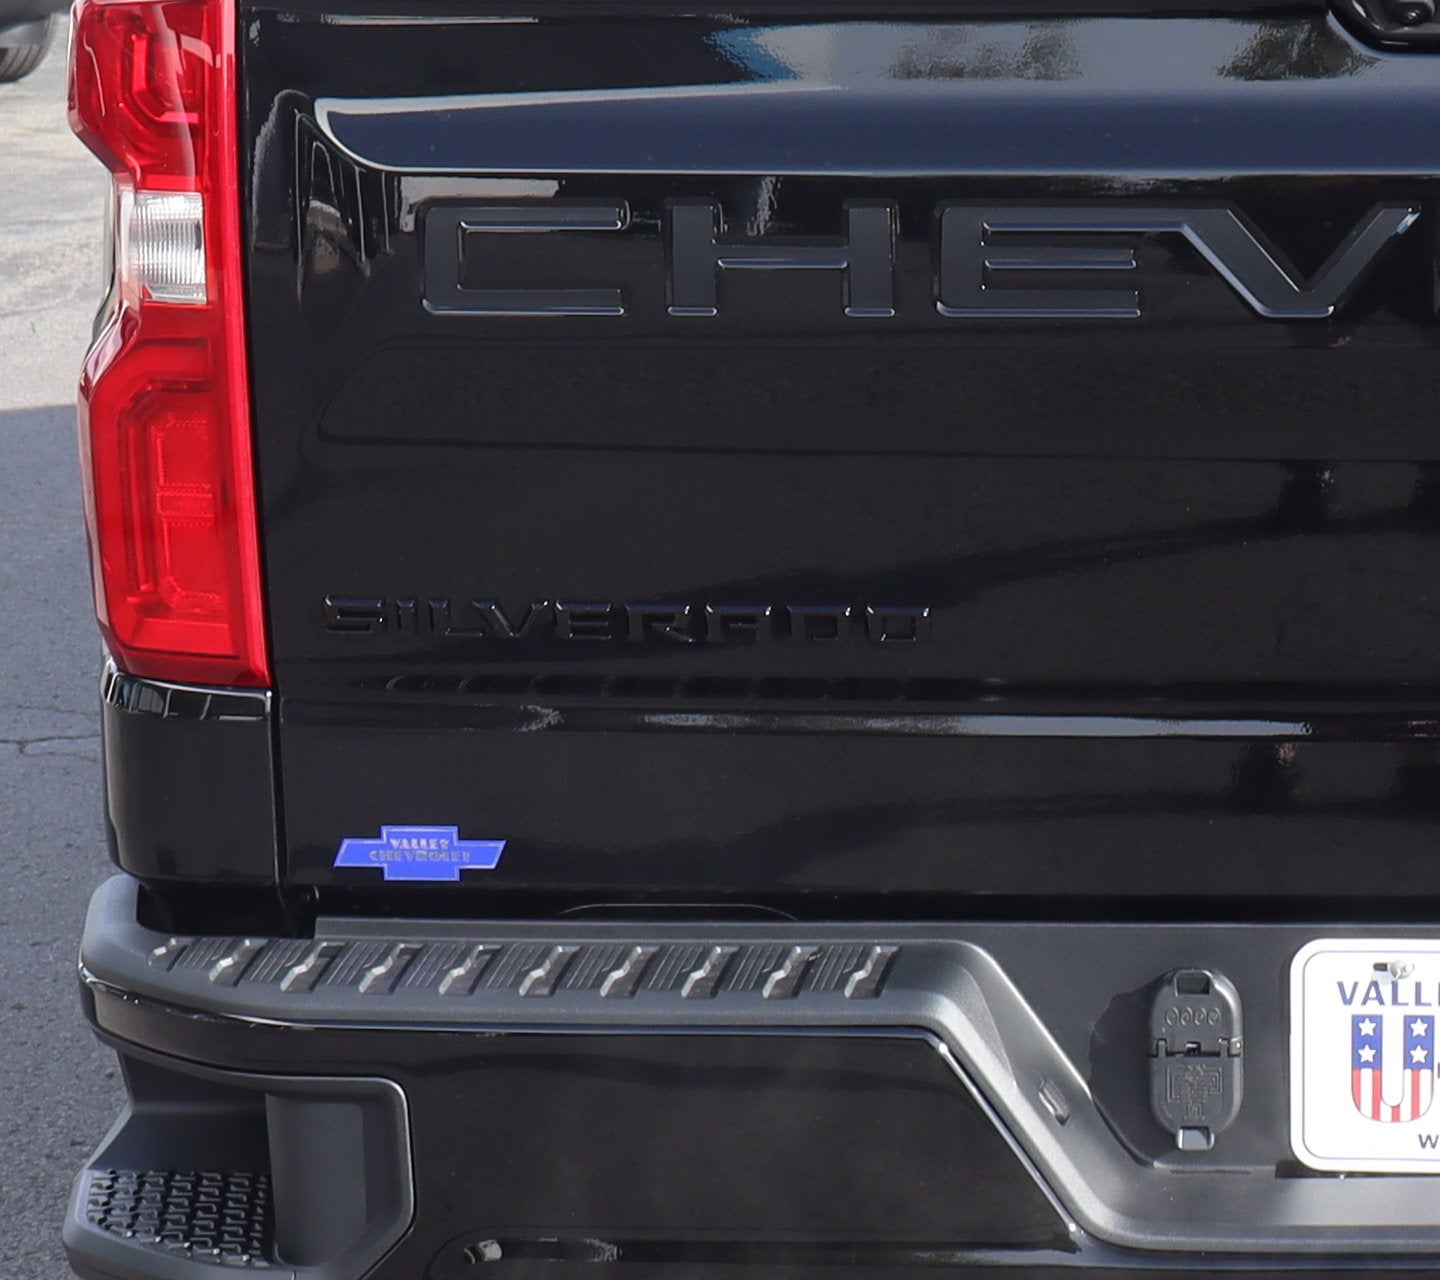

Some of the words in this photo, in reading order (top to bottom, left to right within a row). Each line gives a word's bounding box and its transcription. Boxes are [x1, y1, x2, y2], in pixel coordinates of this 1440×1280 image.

[324, 597, 931, 644] SILVERADO
[389, 838, 450, 850] VALLEY
[368, 850, 472, 862] CHEVROLET
